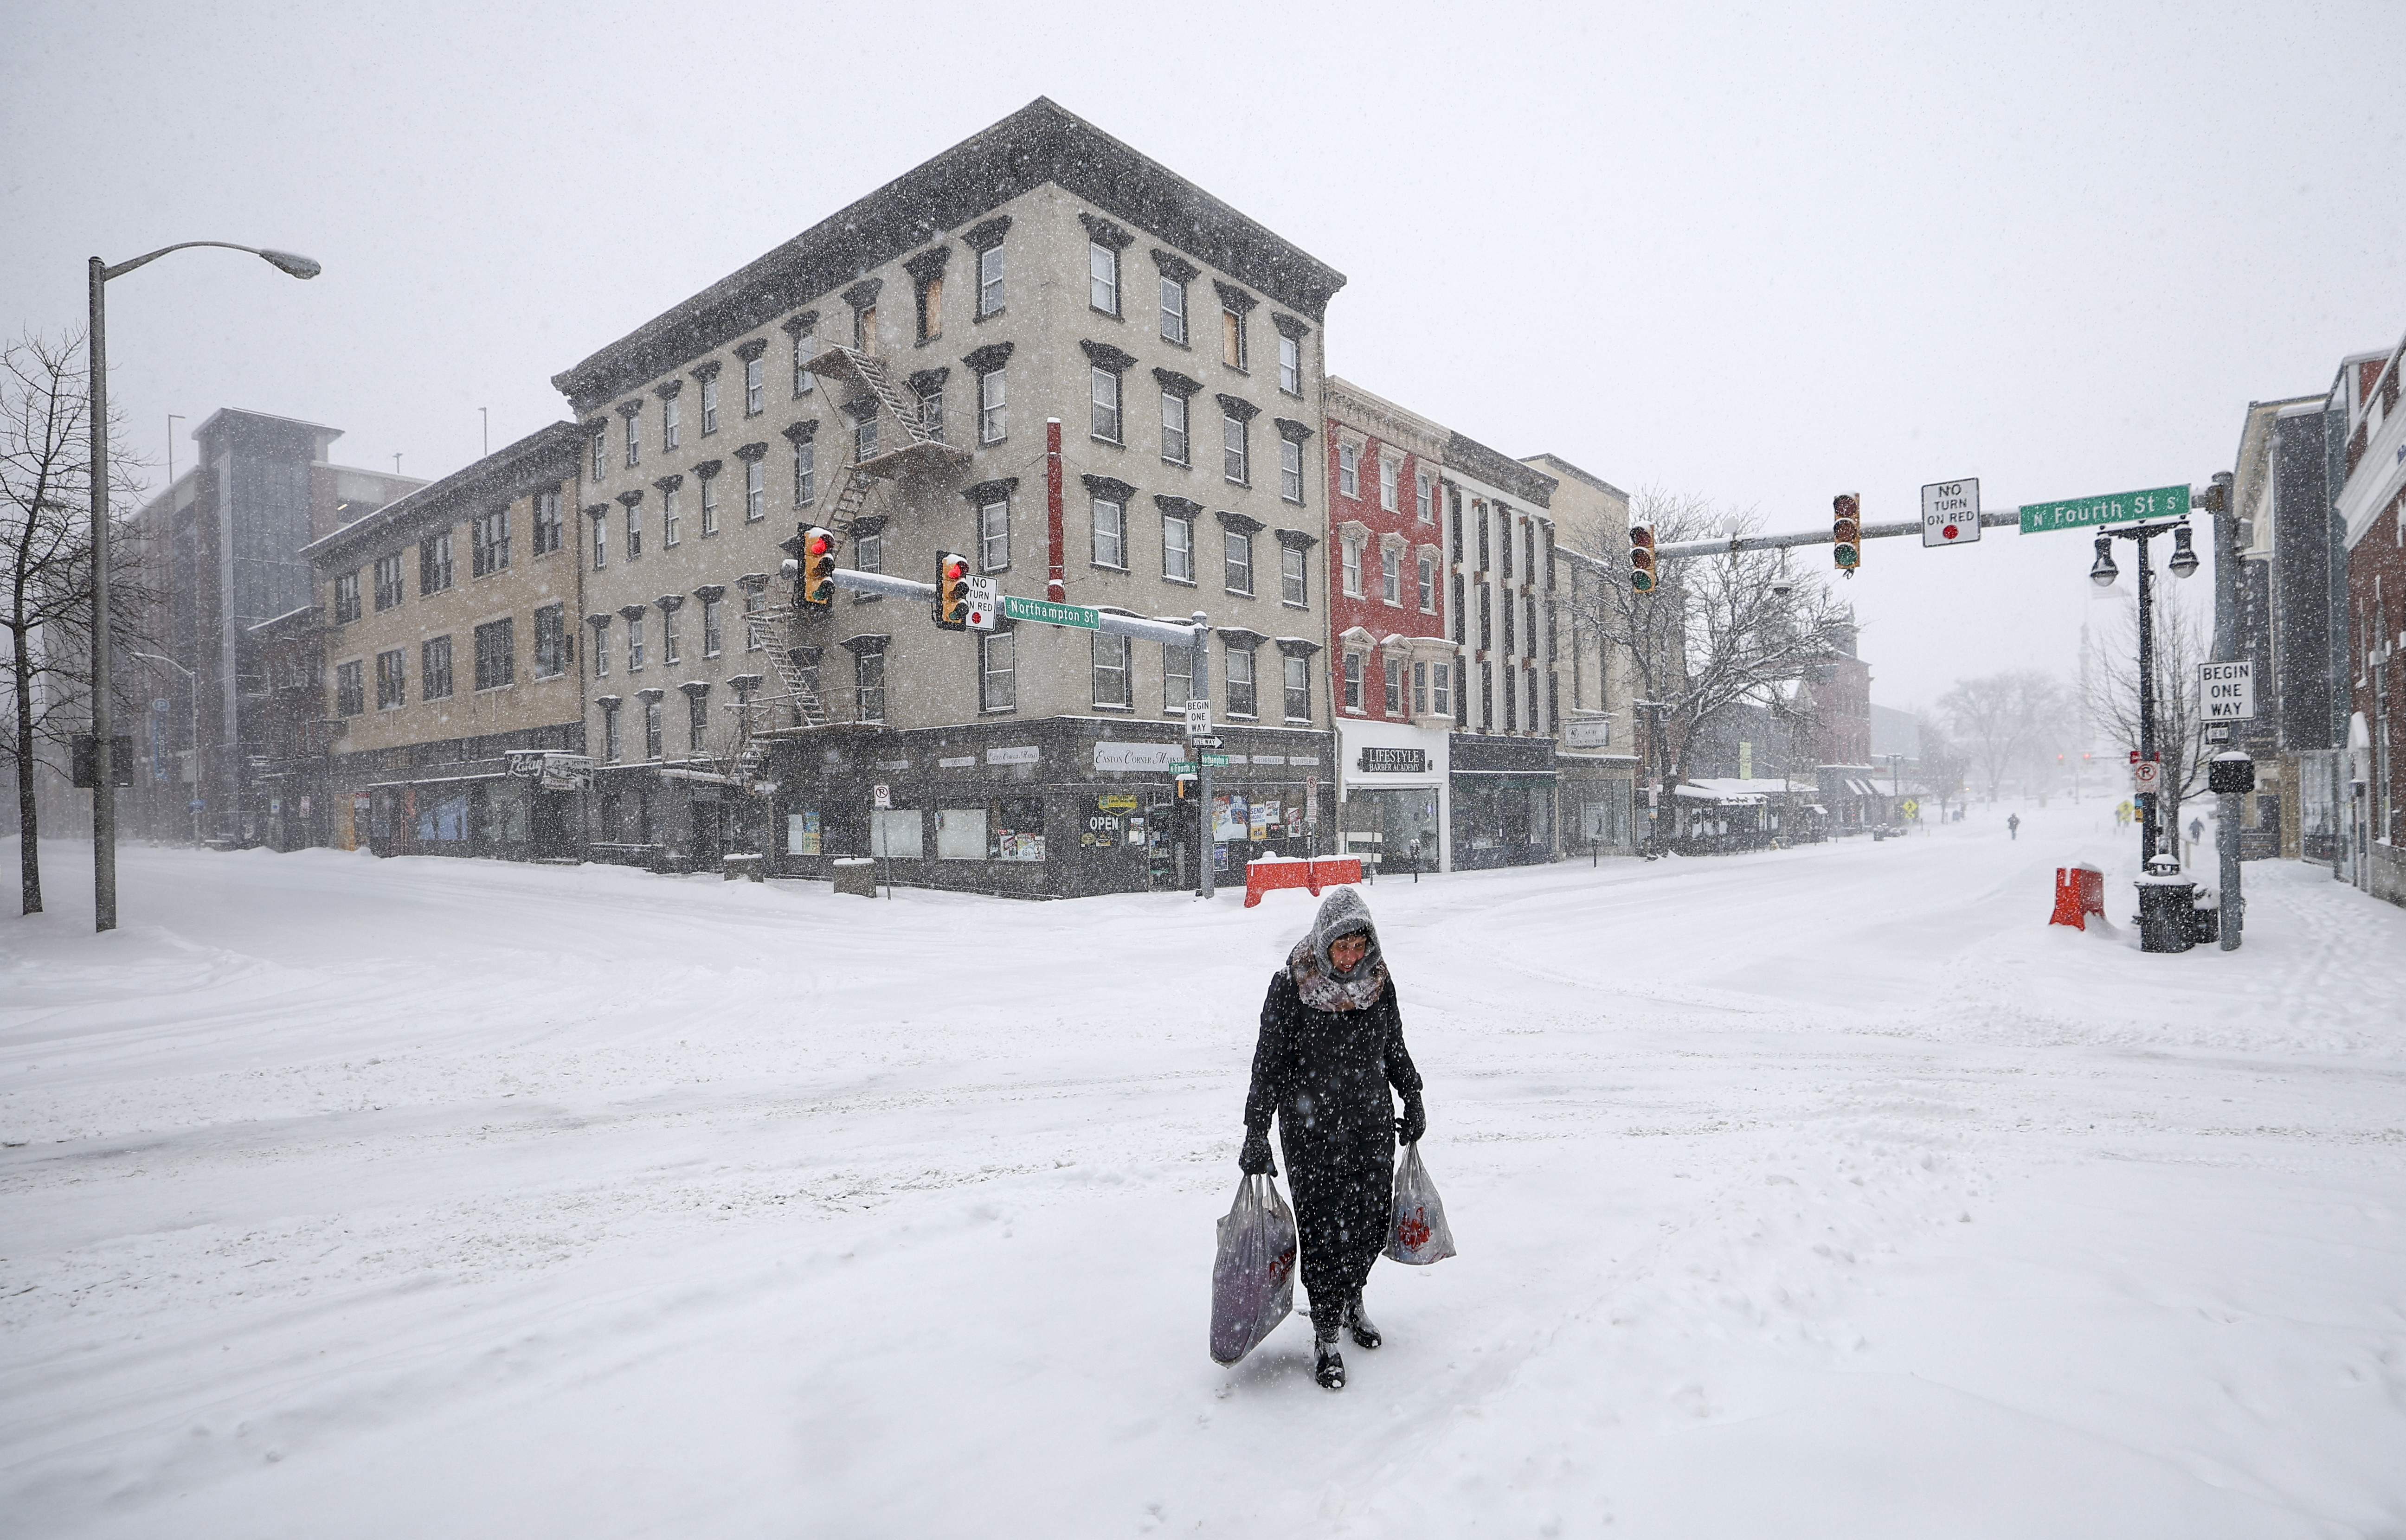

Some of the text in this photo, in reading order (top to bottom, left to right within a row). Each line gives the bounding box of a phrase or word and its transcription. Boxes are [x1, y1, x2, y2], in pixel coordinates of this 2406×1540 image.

[1939, 483, 1962, 497] NO
[1934, 498, 1967, 511] TURN
[2033, 513, 2043, 526] N
[2054, 501, 2122, 524] Fourth
[2135, 495, 2155, 513] St
[1928, 511, 1974, 525] ON RED
[972, 577, 987, 588] NO
[969, 590, 989, 600] TURN
[967, 601, 992, 611] N RED
[1011, 600, 1094, 623] Northampton St
[2204, 665, 2249, 680] BEGIN
[2211, 684, 2242, 698] ONE
[1188, 701, 1209, 710] BEGIN
[2211, 702, 2242, 716] WAY
[1191, 712, 1205, 721] ONE
[1191, 724, 1206, 732] WAY
[1202, 755, 1224, 765] Northampton
[1370, 749, 1420, 763] LIFESTYLE
[1175, 764, 1190, 772] Fourth
[1090, 817, 1118, 830] OPEN
